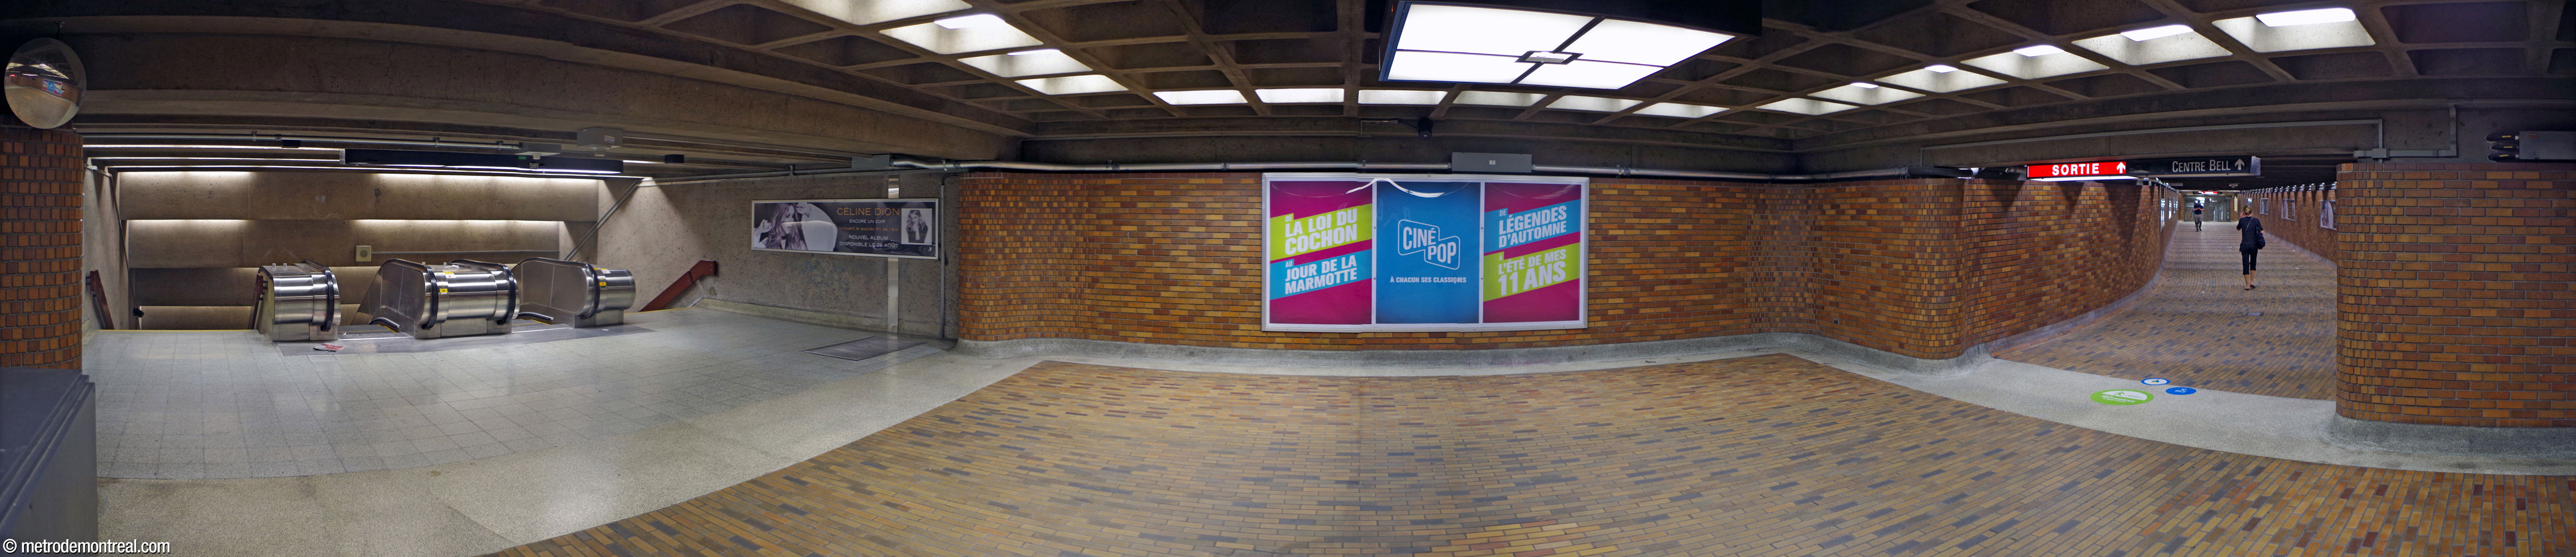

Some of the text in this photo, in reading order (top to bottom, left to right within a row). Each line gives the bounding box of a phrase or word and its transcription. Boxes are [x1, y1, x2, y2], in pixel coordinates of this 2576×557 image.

[2052, 163, 2099, 176] SORTIE
[2172, 159, 2231, 173] CENTRE BELL
[837, 207, 872, 216] CÉLINE
[1285, 208, 1357, 238] LA LOI DU
[1499, 205, 1567, 235] LÉGENDES
[1285, 223, 1357, 255] COCHON
[1403, 227, 1436, 250] CINÉ
[1499, 221, 1567, 248] D'AUTOMNE
[1427, 242, 1457, 264] POP
[1498, 248, 1567, 275] L'ÉTÉ DE MES
[1285, 255, 1357, 281] JOUR DE LA
[1285, 267, 1357, 295] MARMOTTE
[1498, 261, 1566, 296] 11 ANS
